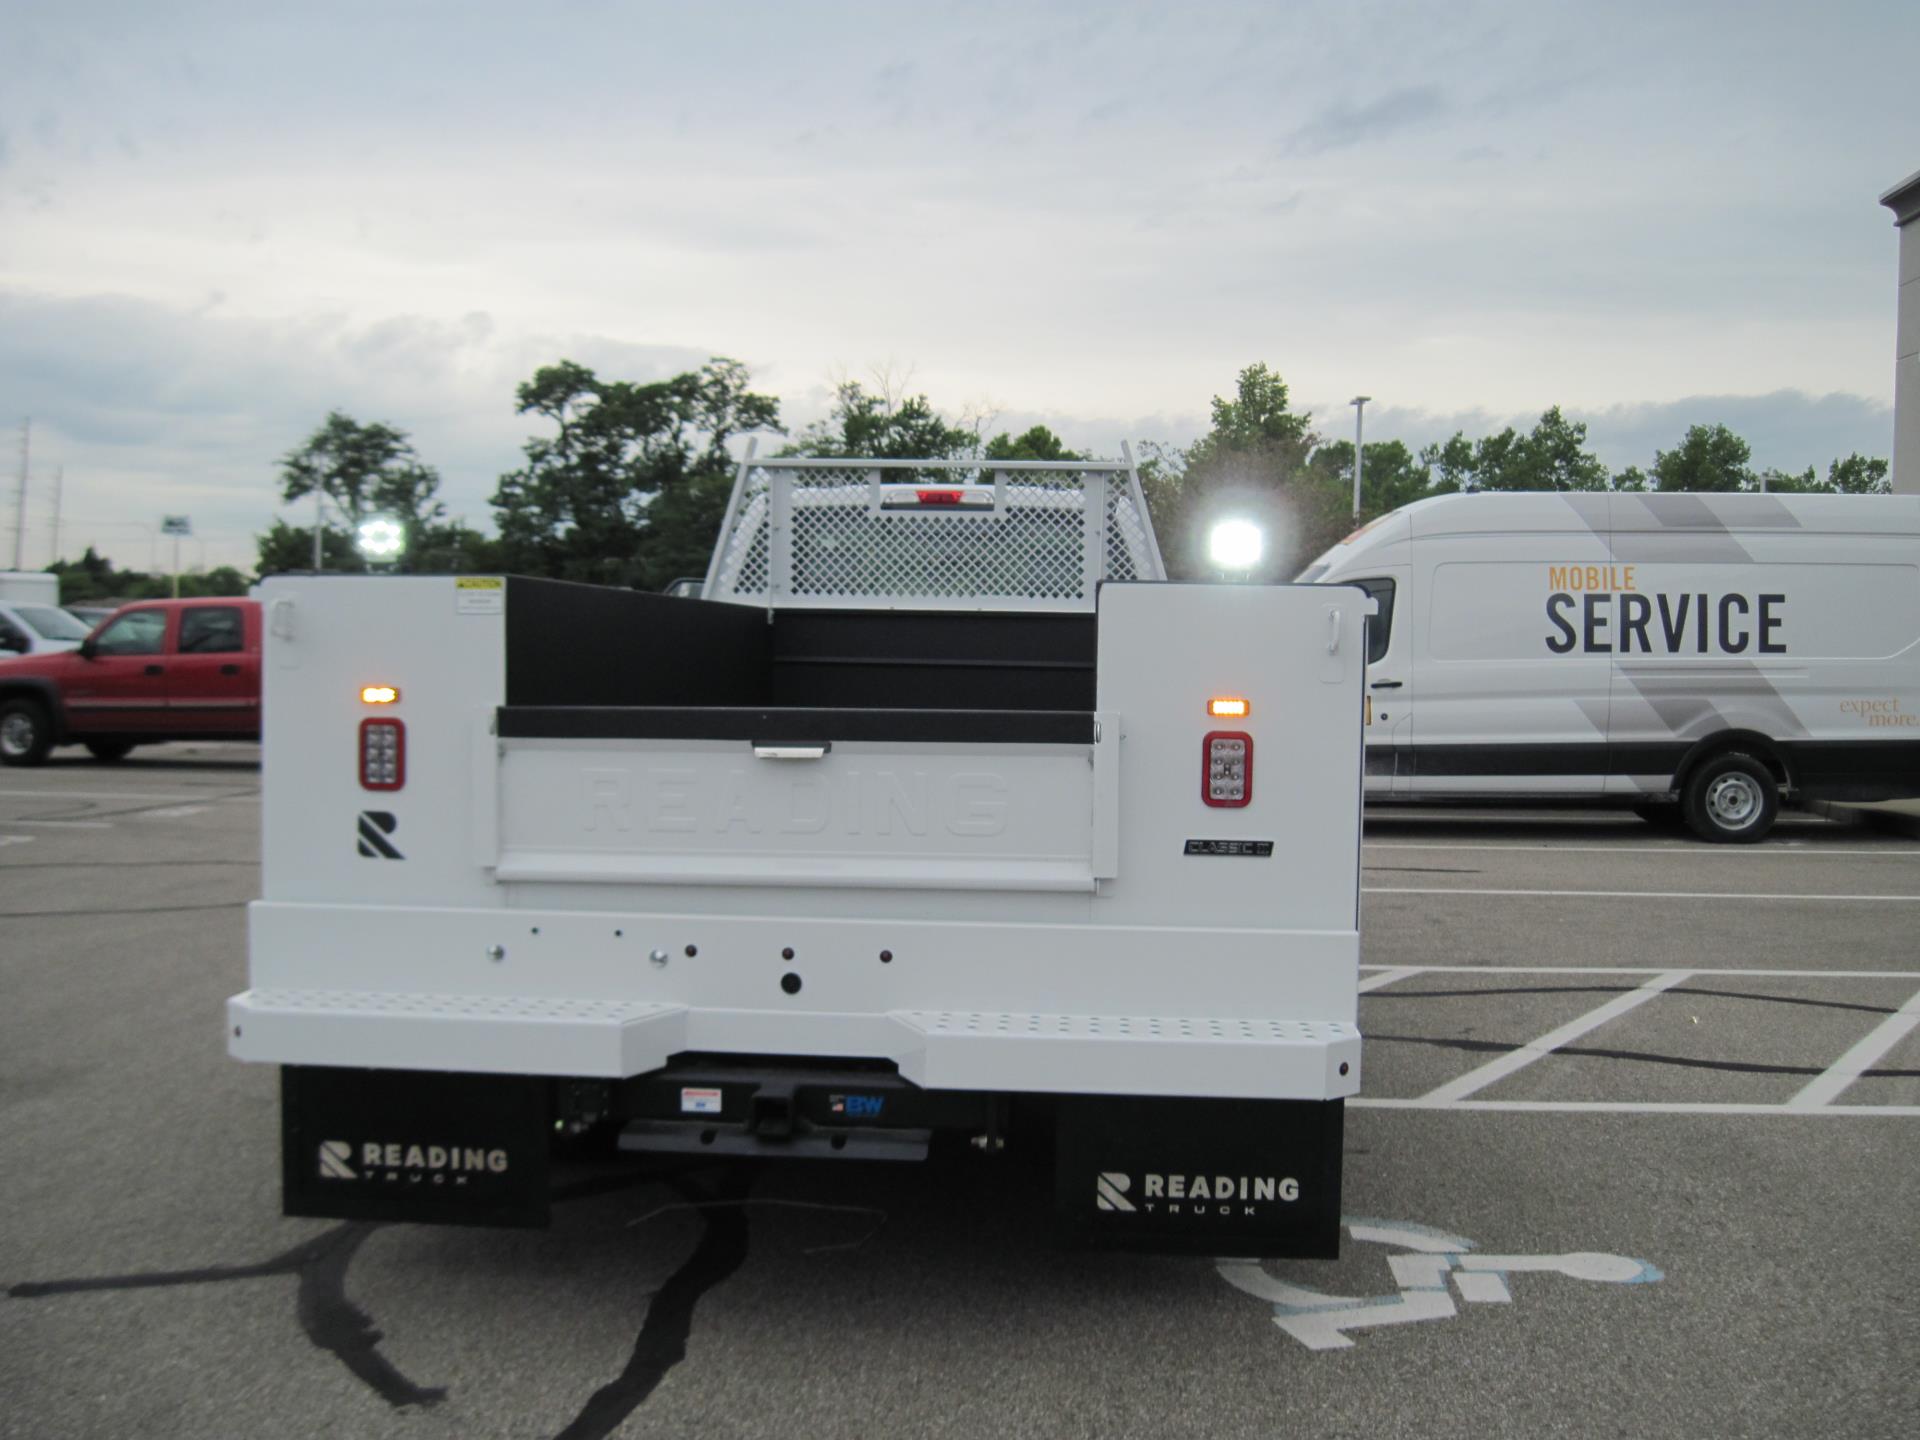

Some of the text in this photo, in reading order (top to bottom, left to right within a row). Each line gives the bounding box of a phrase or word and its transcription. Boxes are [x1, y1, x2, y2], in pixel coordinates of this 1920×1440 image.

[1549, 566, 1636, 591] MOBILE
[1545, 592, 1788, 654] SERVICE
[1839, 697, 1899, 717] expect
[581, 768, 1008, 837] READING
[1188, 841, 1253, 854] CLASSIC
[363, 1142, 508, 1173] READING
[1145, 1173, 1299, 1202] READING
[1145, 1203, 1256, 1216] TRUCK
